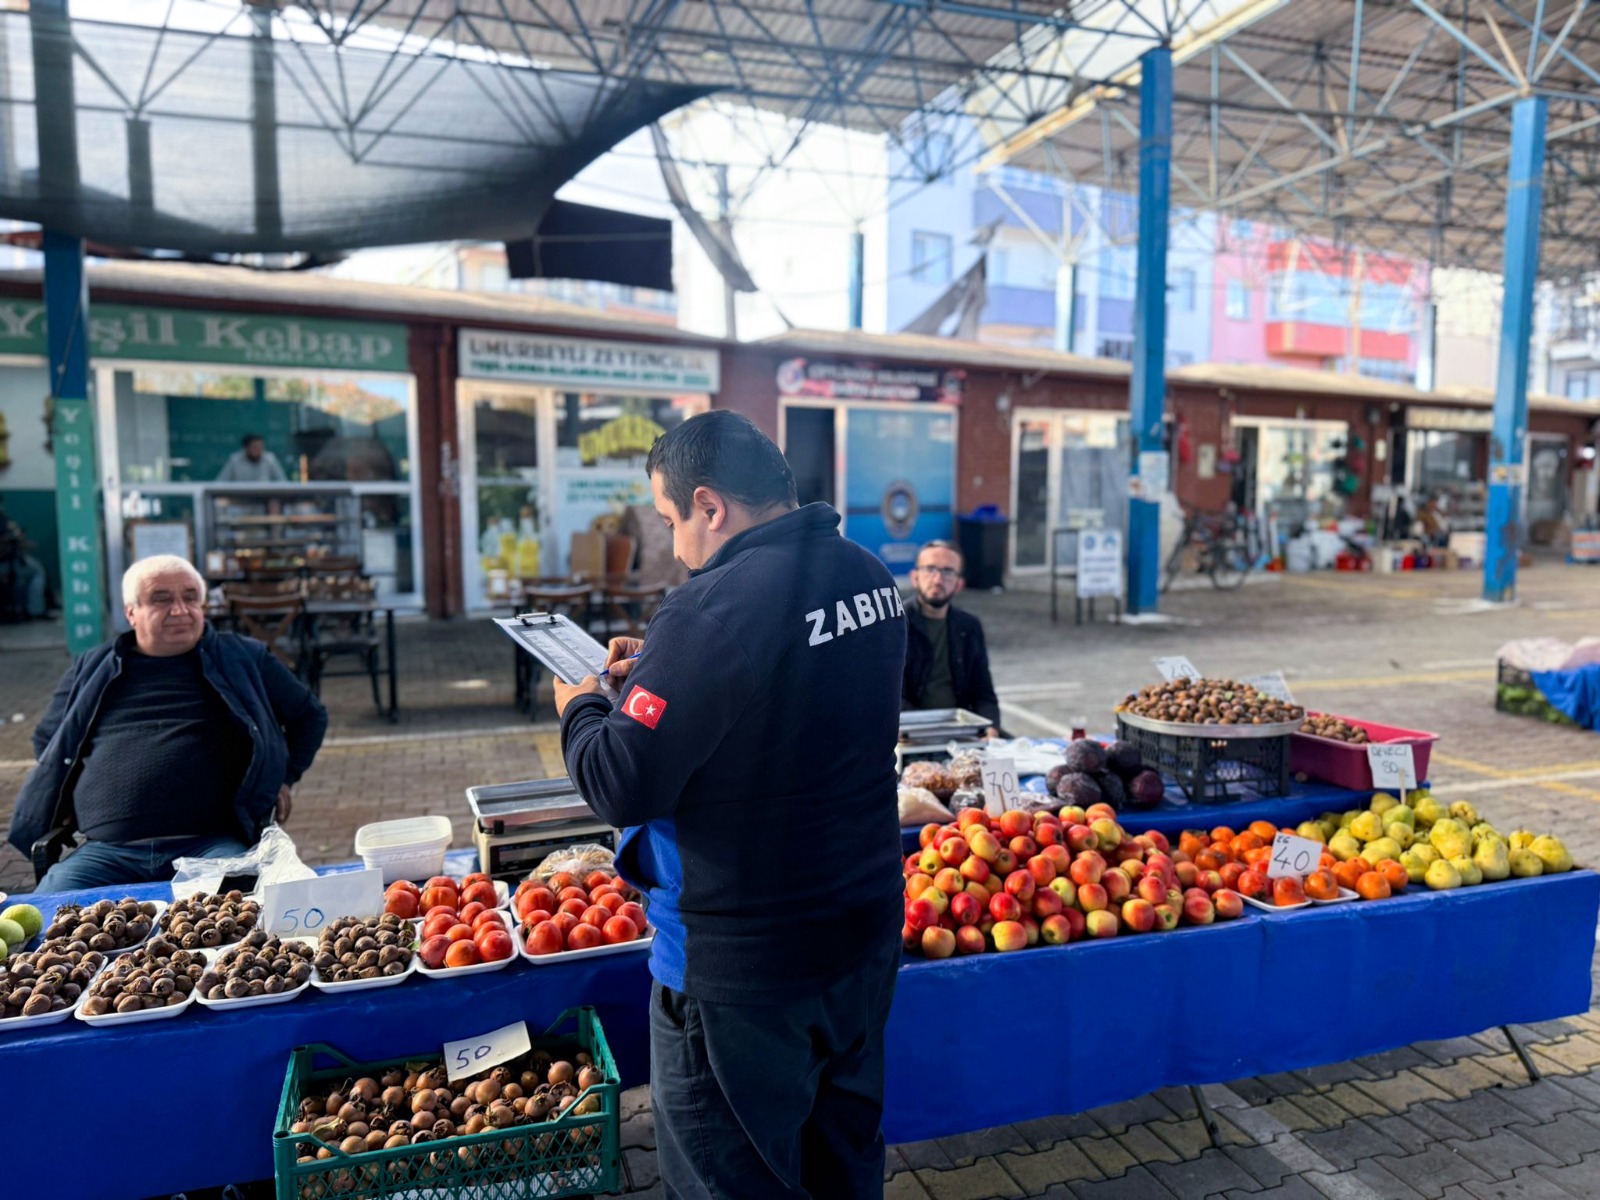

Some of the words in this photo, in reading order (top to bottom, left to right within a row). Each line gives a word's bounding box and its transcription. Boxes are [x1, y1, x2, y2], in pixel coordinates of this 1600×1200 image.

[0, 303, 179, 353] Yşil
[203, 317, 393, 362] Kebap
[805, 586, 905, 647] ZABITA
[986, 771, 1014, 797] 70
[1273, 846, 1311, 872] 40
[282, 907, 325, 933] 50
[456, 1045, 492, 1070] 50
